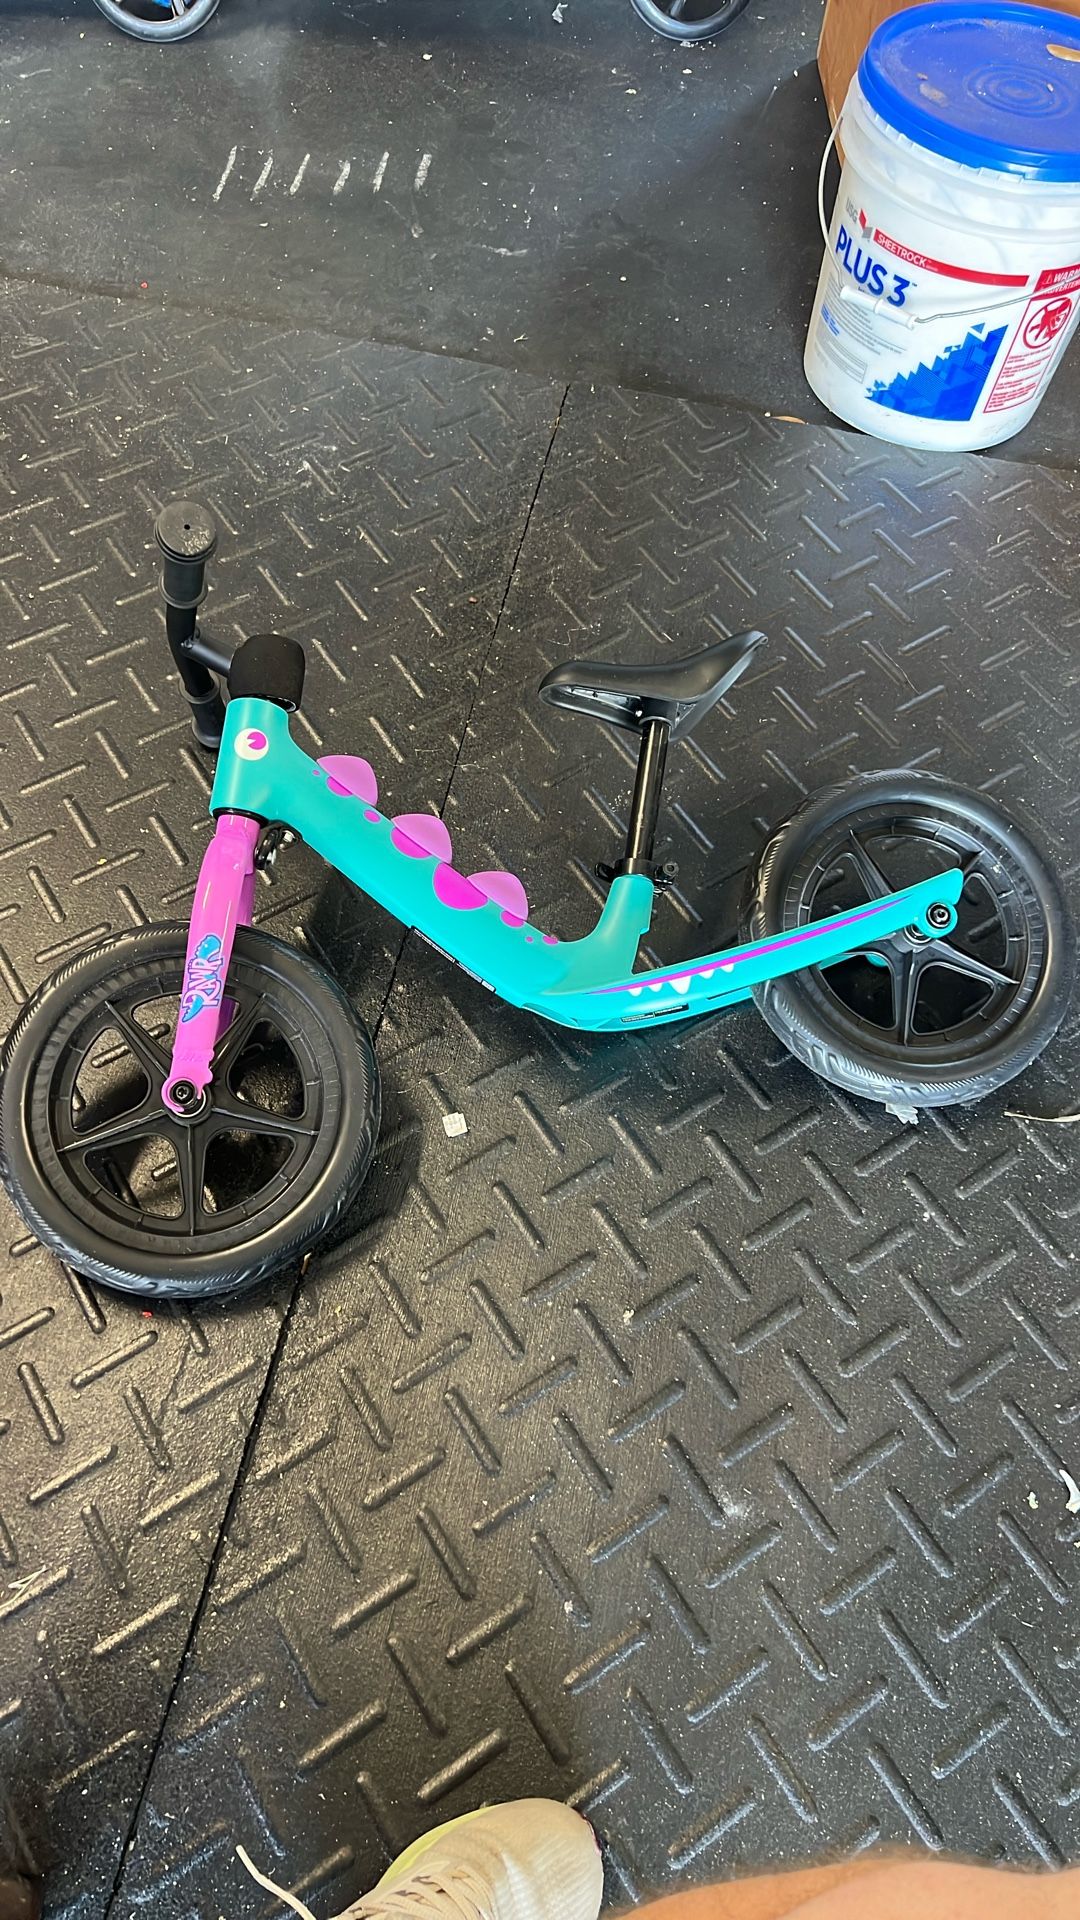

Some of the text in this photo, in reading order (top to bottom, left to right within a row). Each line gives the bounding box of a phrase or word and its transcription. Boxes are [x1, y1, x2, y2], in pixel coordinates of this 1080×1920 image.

[835, 223, 911, 307] PLUS 3
[876, 233, 929, 269] SHEETROCK
[182, 955, 223, 1009] RAWR
